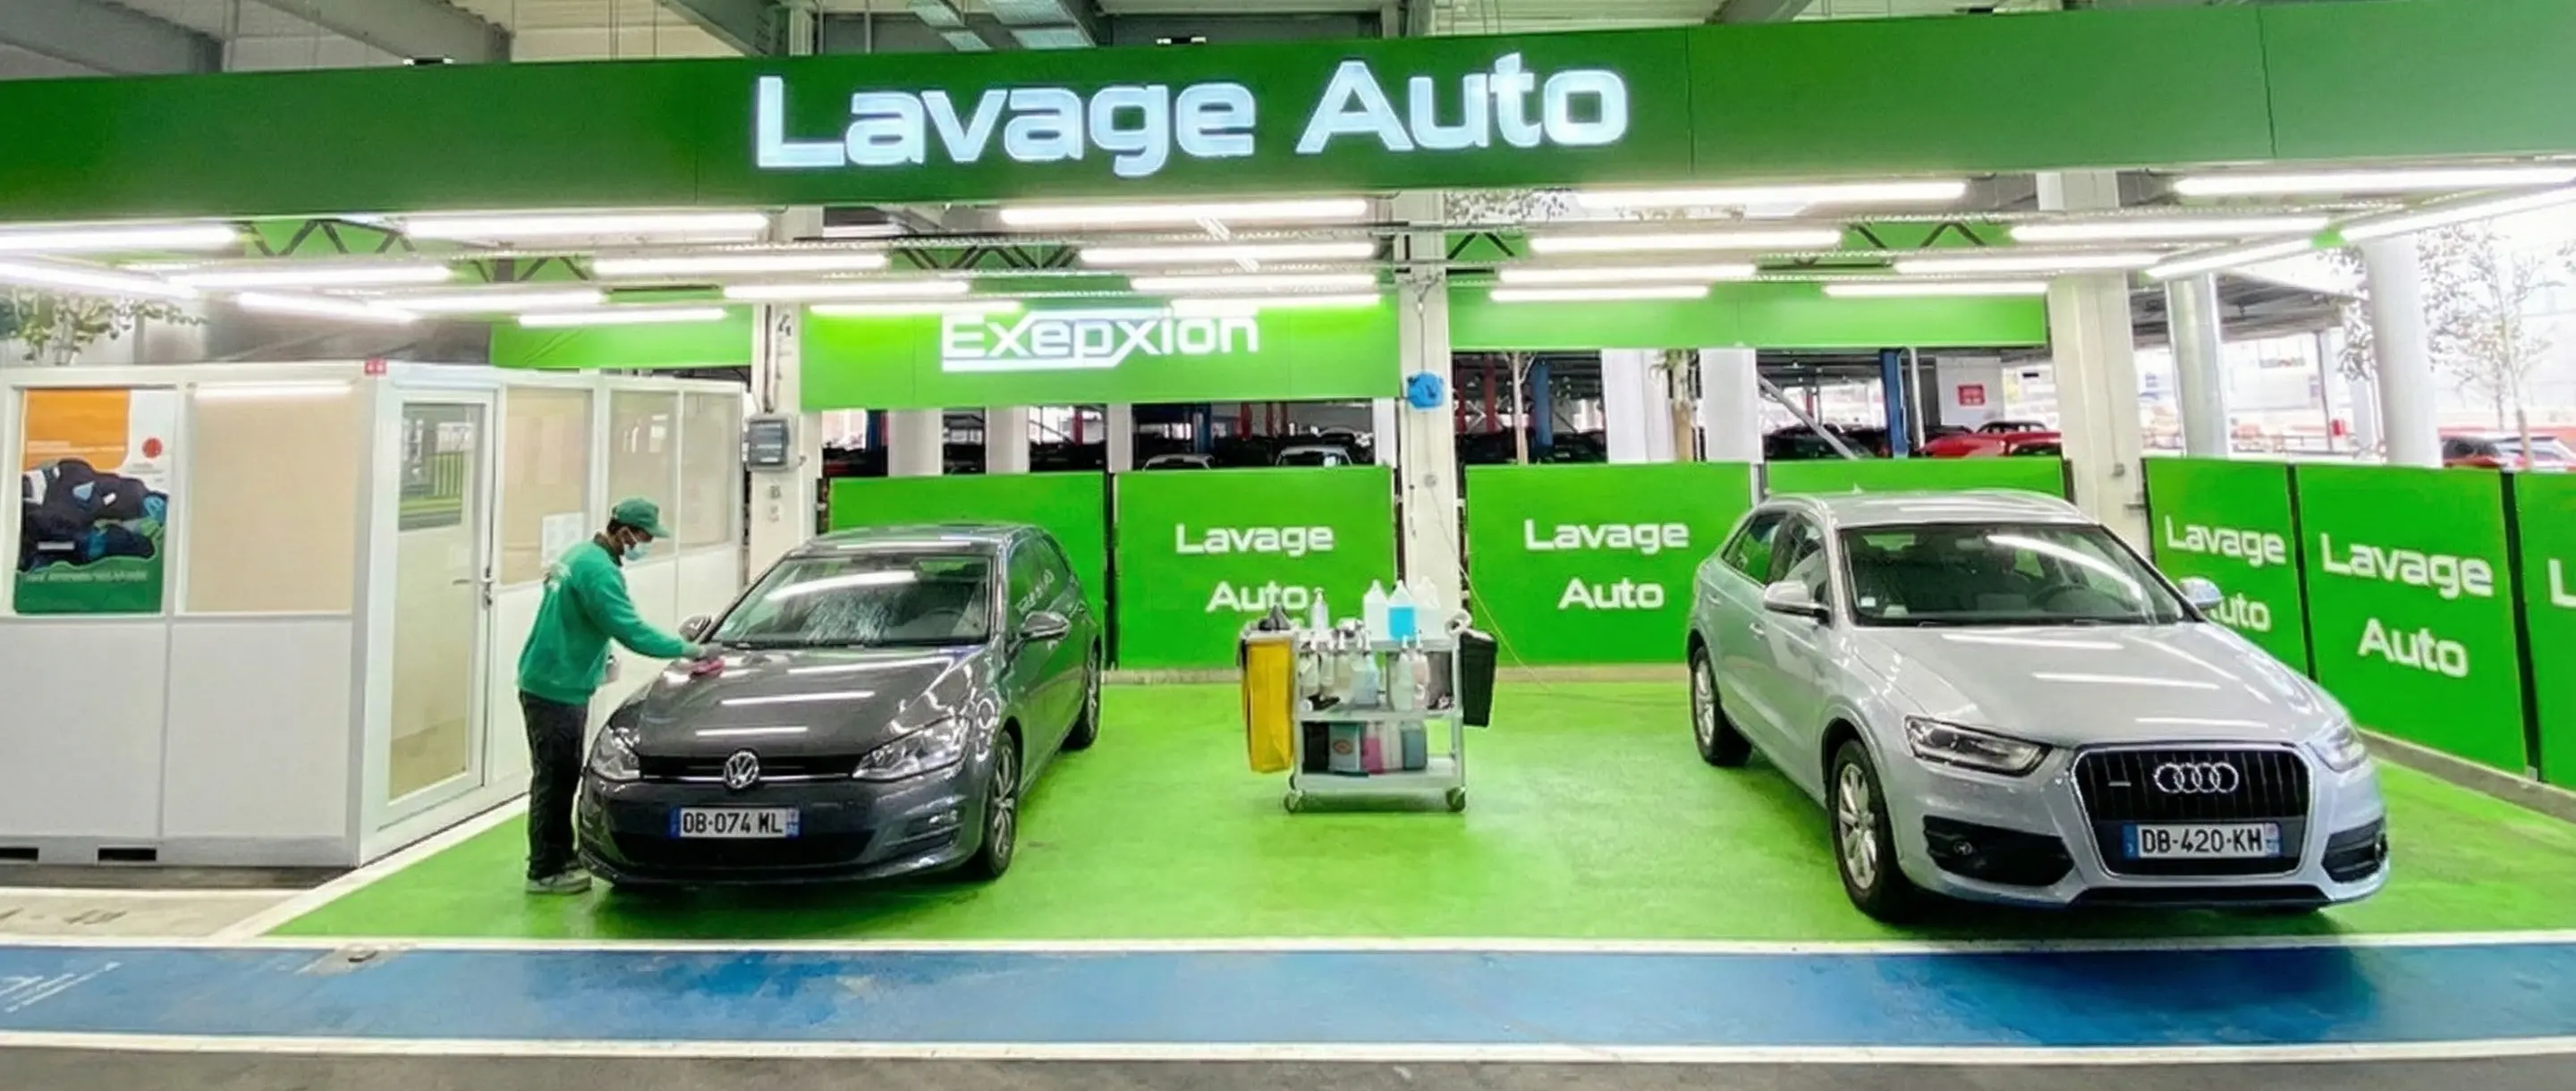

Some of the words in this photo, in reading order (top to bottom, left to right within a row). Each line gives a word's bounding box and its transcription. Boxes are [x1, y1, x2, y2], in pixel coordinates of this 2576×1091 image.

[756, 75, 1255, 177] Lavage
[1295, 52, 1630, 153] Auto
[941, 311, 1260, 361] Exepxion
[1174, 522, 1335, 558] Lavage
[1524, 518, 1690, 555] Lavage
[2165, 514, 2287, 568] Lavage
[2320, 532, 2494, 599] Lavage
[1205, 580, 1309, 613] Auto
[1557, 577, 1665, 610] Auto
[2209, 591, 2272, 631] uto
[2357, 617, 2469, 678] Auto
